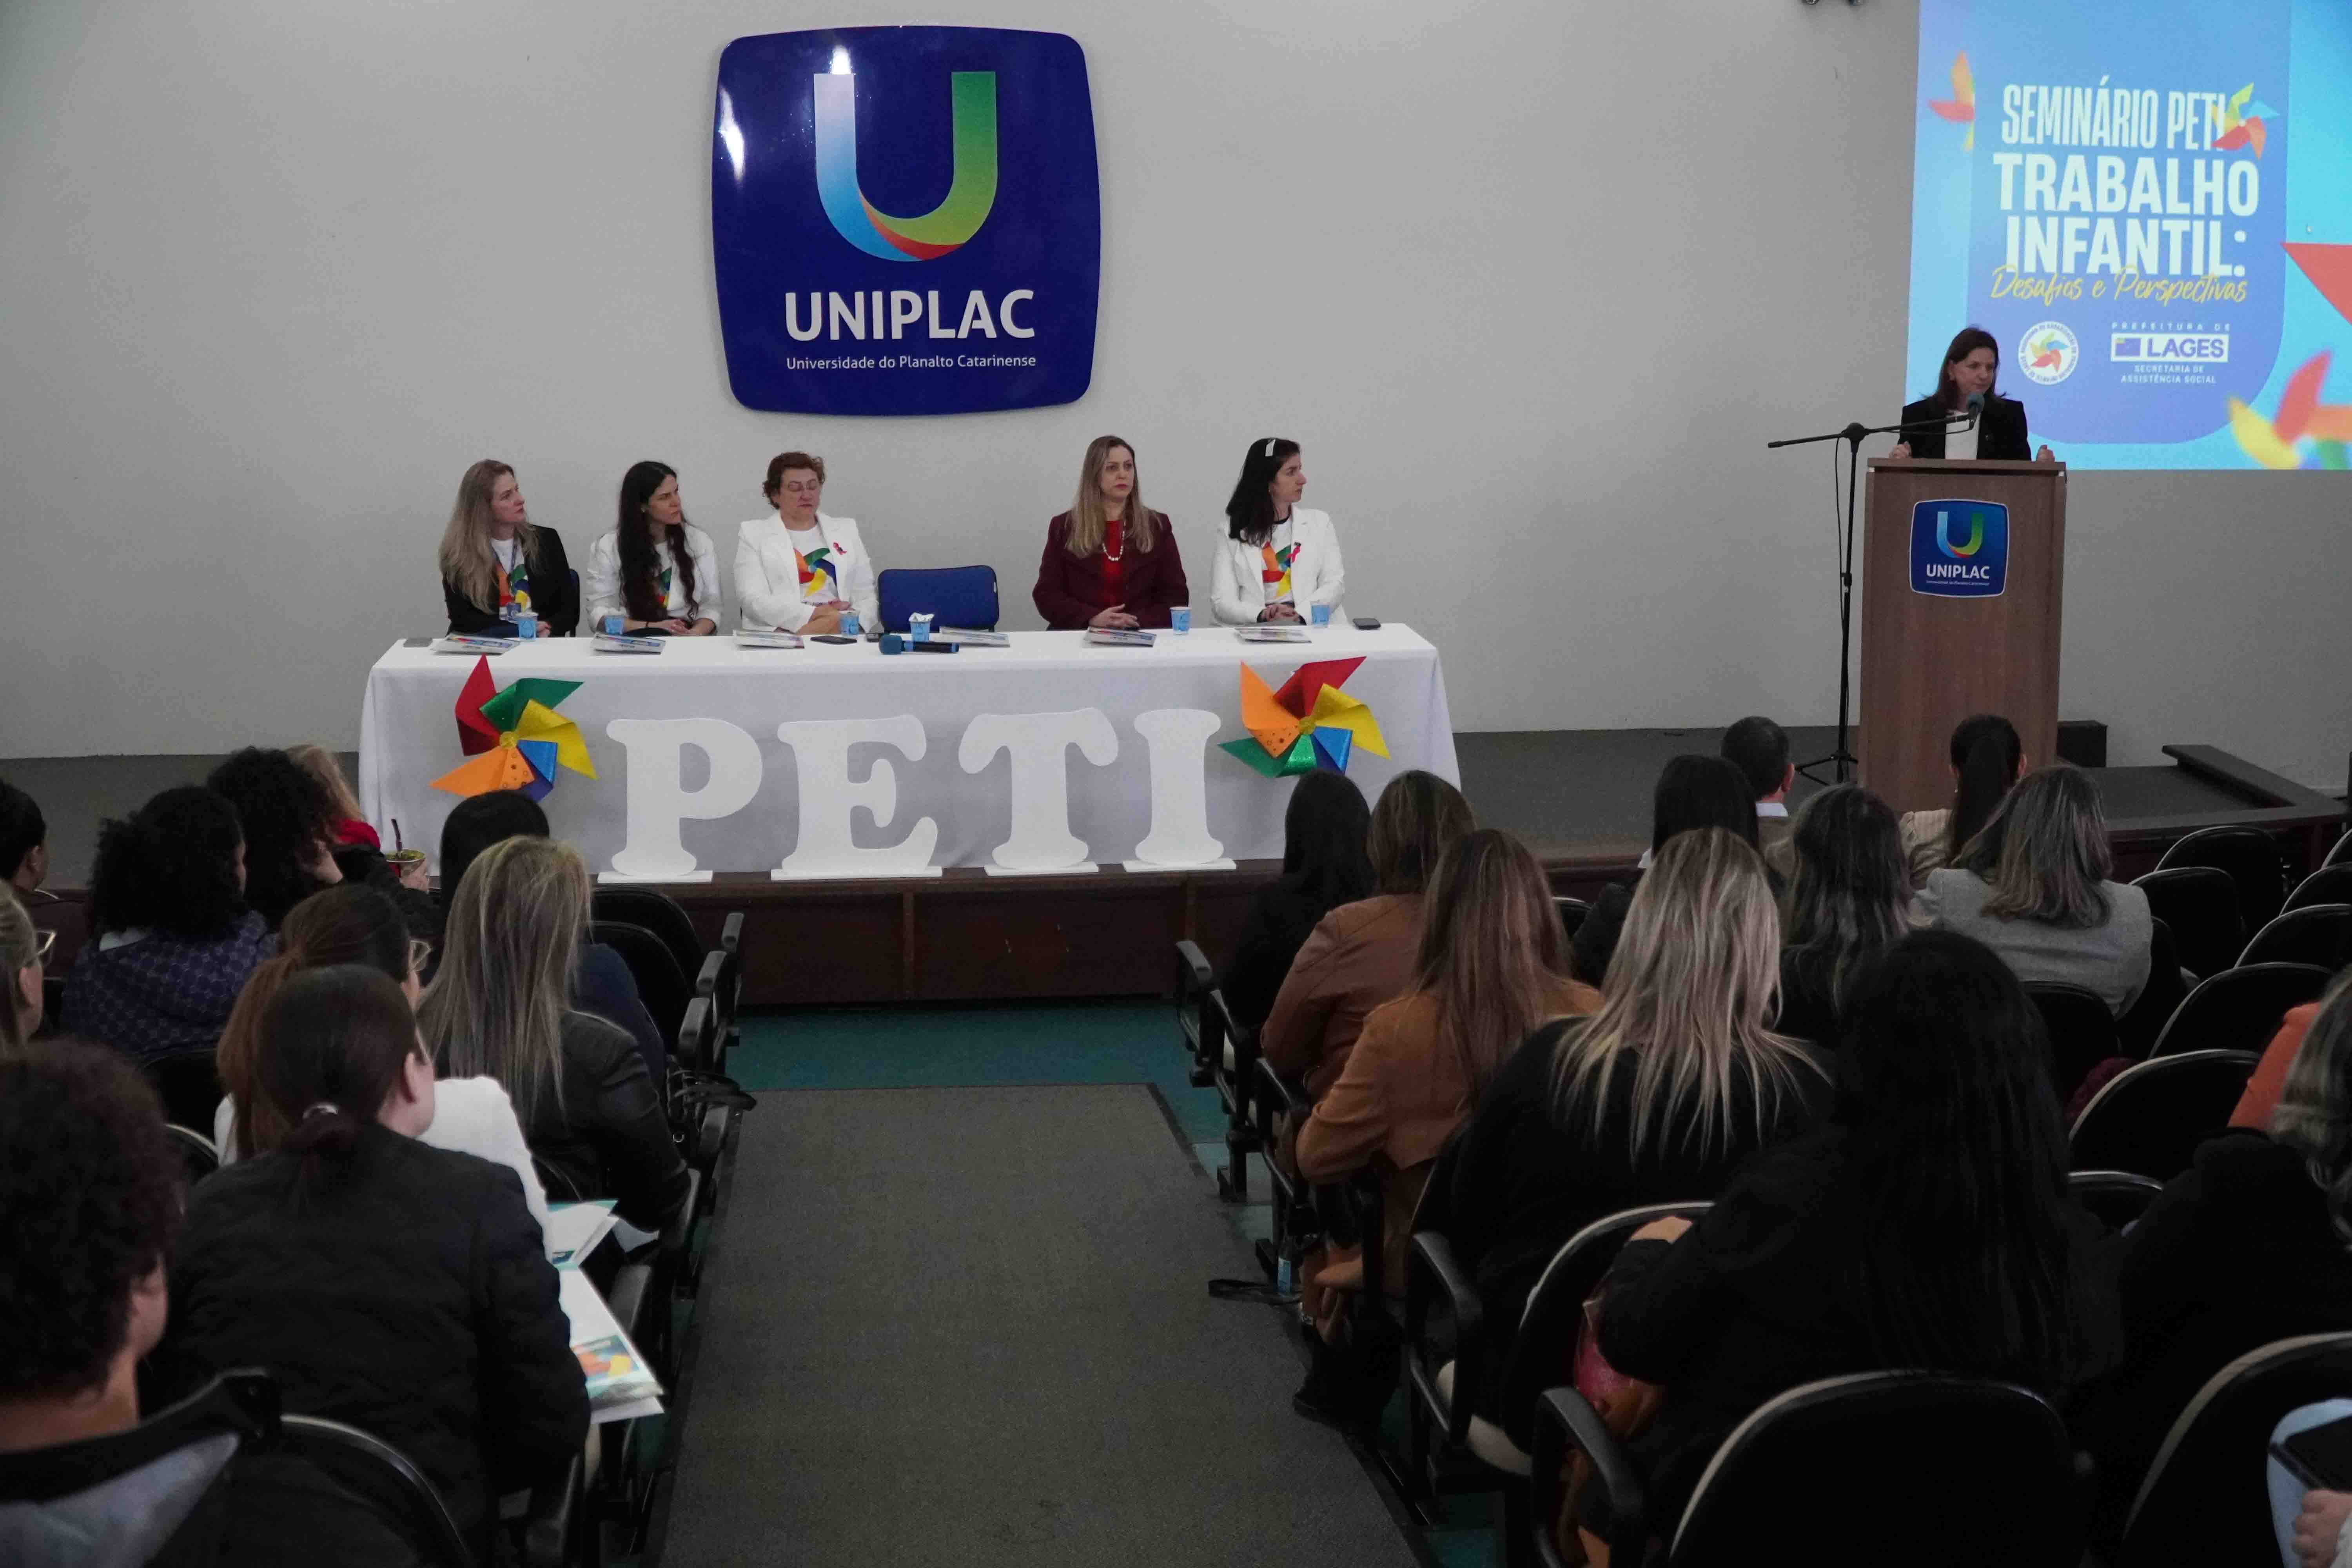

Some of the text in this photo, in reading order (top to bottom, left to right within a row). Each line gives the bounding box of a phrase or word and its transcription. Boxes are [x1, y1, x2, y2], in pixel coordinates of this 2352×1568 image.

[2002, 75, 2225, 151] SEMINÁRIO PETI
[1993, 152, 2259, 217] TRABALHO
[2006, 216, 2247, 277] INFANTIL:
[1991, 263, 2248, 308] Desafios e Perspectivas
[785, 290, 1035, 341] UNIPLAC
[2112, 321, 2230, 331] PREFEITURA DE
[787, 354, 1036, 370] Universidade do Planalto Catarinense
[2147, 337, 2225, 358] LAGES
[2120, 373, 2216, 384] ASSISTÊNCIA SOCIAL
[2134, 364, 2204, 374] SECRETARIA DE
[1926, 564, 1990, 579] UNIPLAC
[606, 708, 1225, 878] PETI
